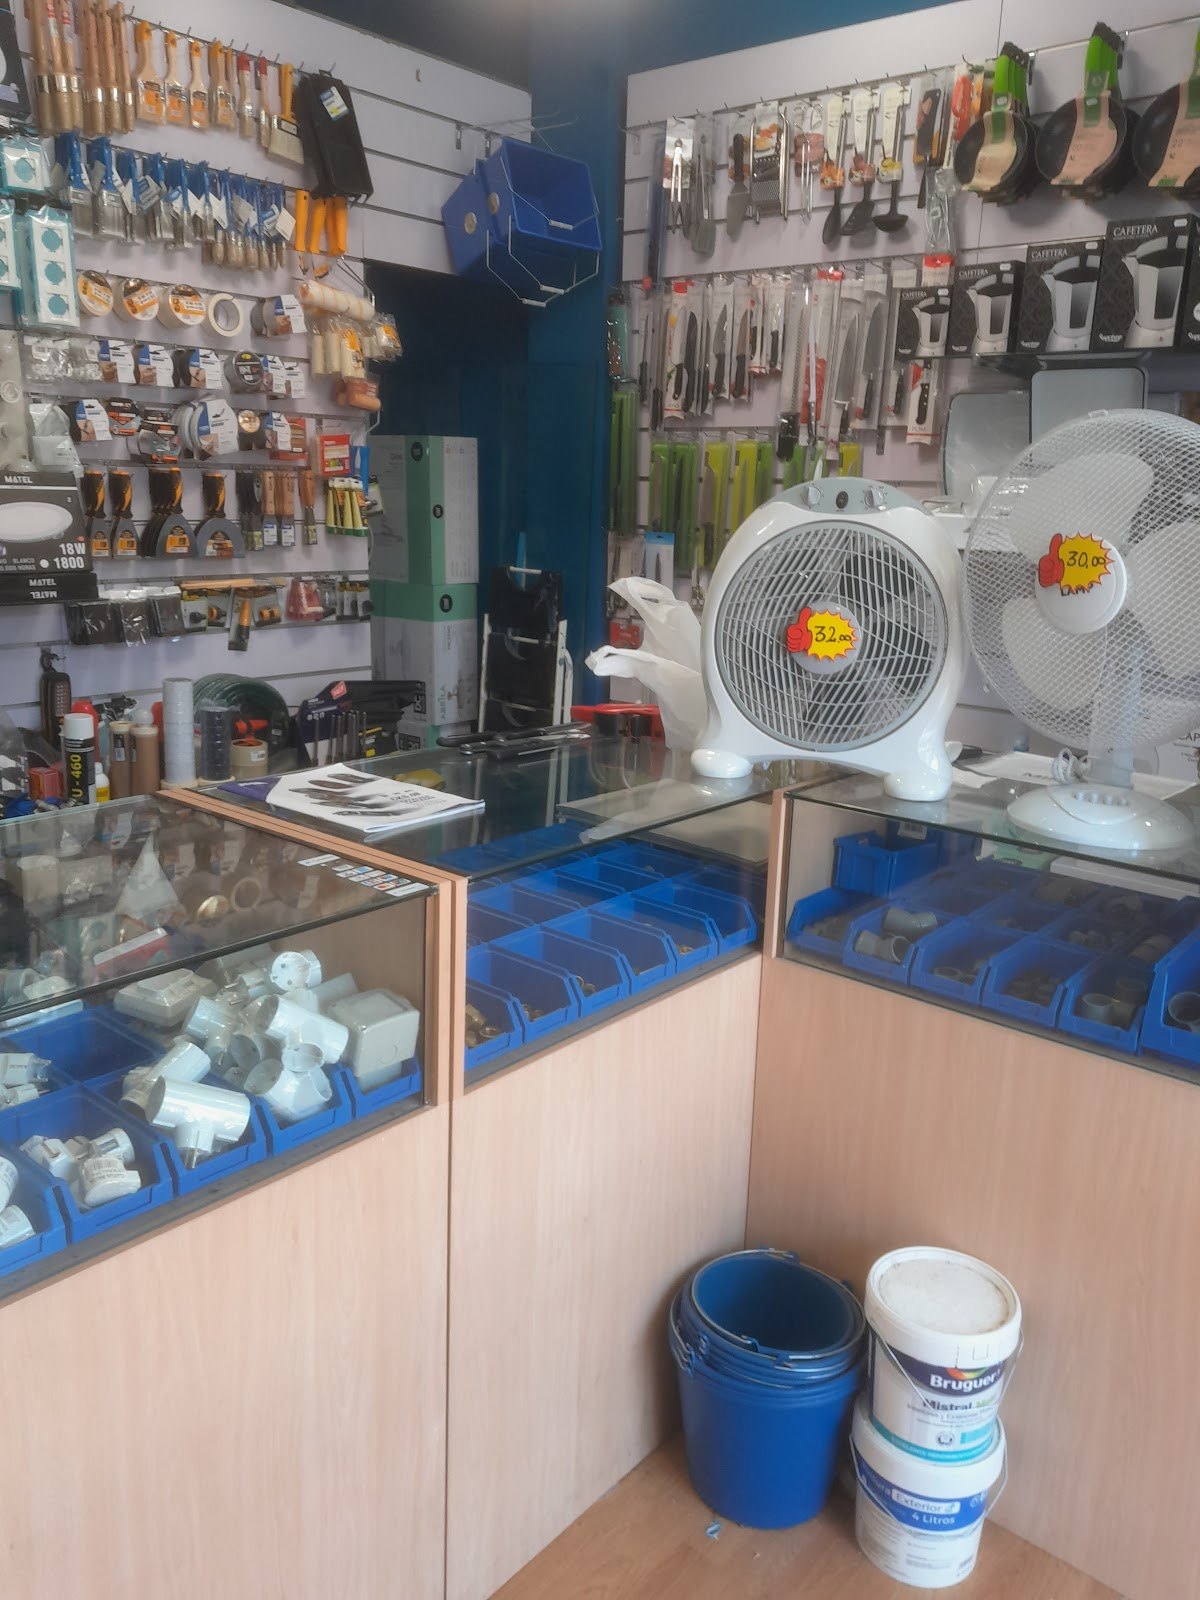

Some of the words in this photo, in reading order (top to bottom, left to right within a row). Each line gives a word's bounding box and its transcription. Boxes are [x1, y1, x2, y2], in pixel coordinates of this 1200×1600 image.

[1113, 224, 1159, 237] CAFETERA
[1031, 248, 1068, 260] CAFETERA
[958, 268, 989, 278] CAFETERA
[901, 290, 928, 299] CAFETERA
[4, 475, 33, 484] MATEL
[59, 543, 86, 555] 18W
[53, 556, 85, 569] 1800
[28, 578, 57, 587] MATEL
[30, 590, 58, 599] MATEL
[70, 753, 82, 779] 460
[929, 1372, 997, 1393] Bruguer
[923, 1398, 972, 1411] Mistral
[895, 1492, 942, 1514] Exterior
[911, 1511, 920, 1522] 4
[922, 1514, 956, 1526] Litros
